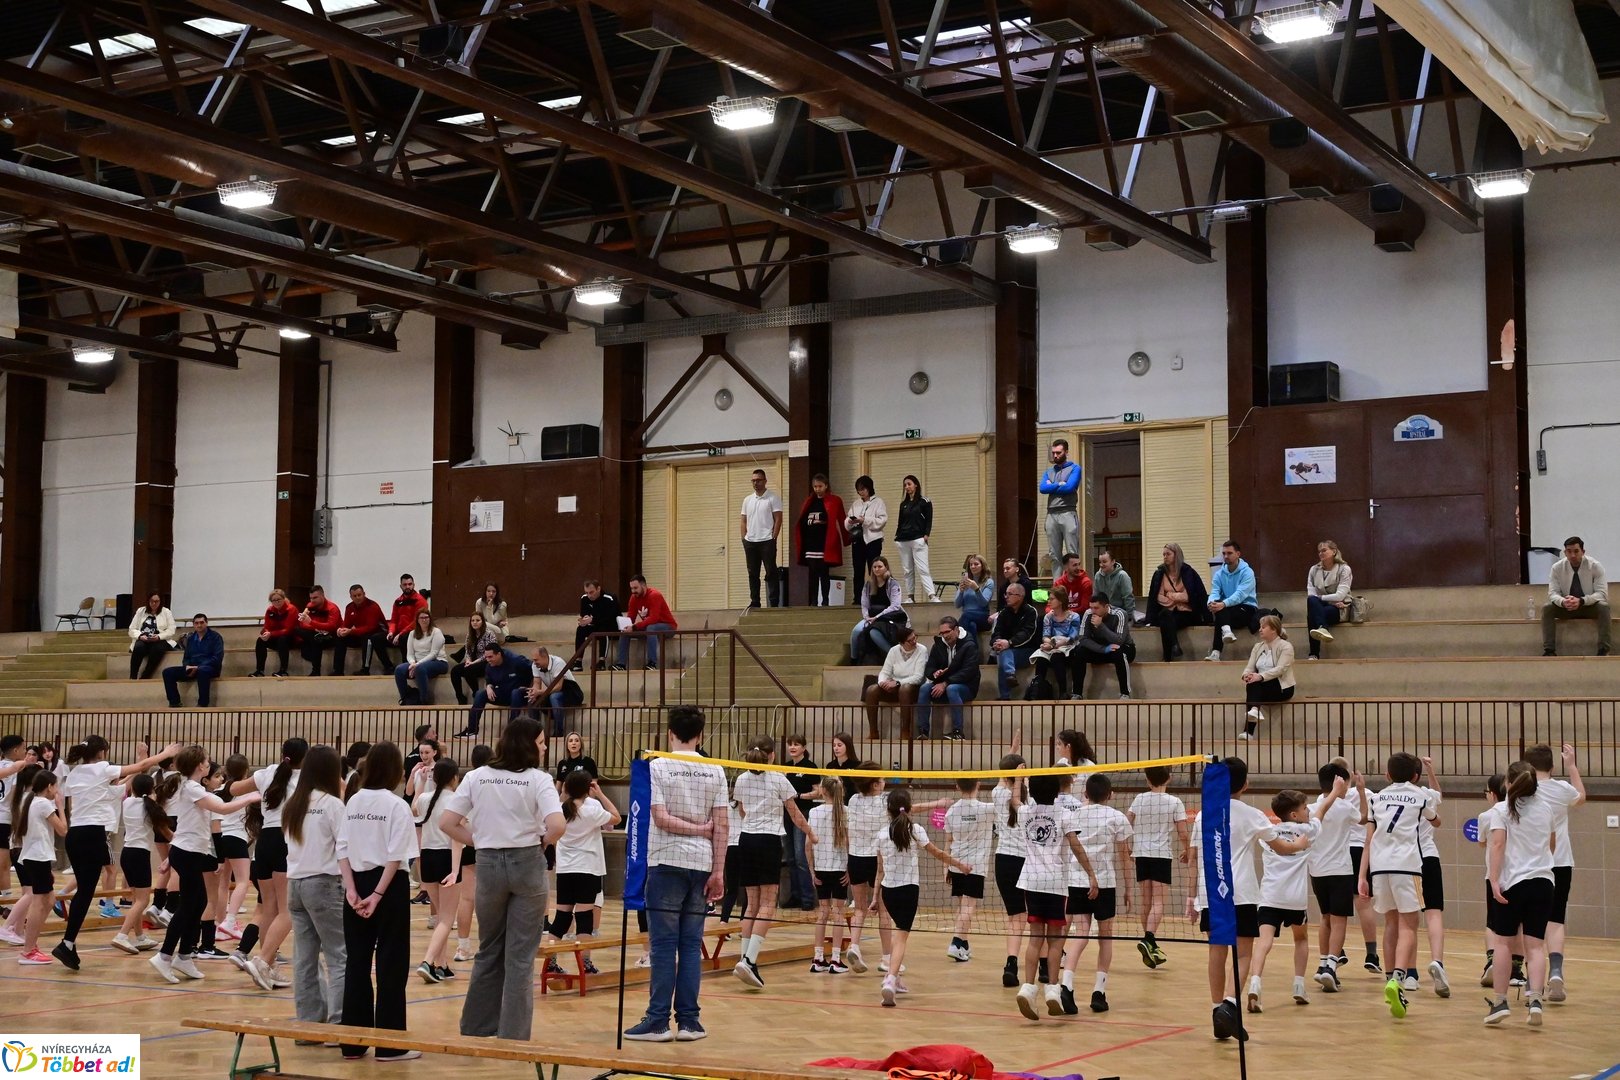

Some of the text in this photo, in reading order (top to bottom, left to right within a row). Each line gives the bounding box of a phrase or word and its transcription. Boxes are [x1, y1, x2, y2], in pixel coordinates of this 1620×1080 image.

[505, 778, 529, 787] Csapat
[1379, 794, 1417, 804] RONALDO
[1386, 804, 1405, 833] 7
[1214, 829, 1225, 881] SCHILDKRÖT
